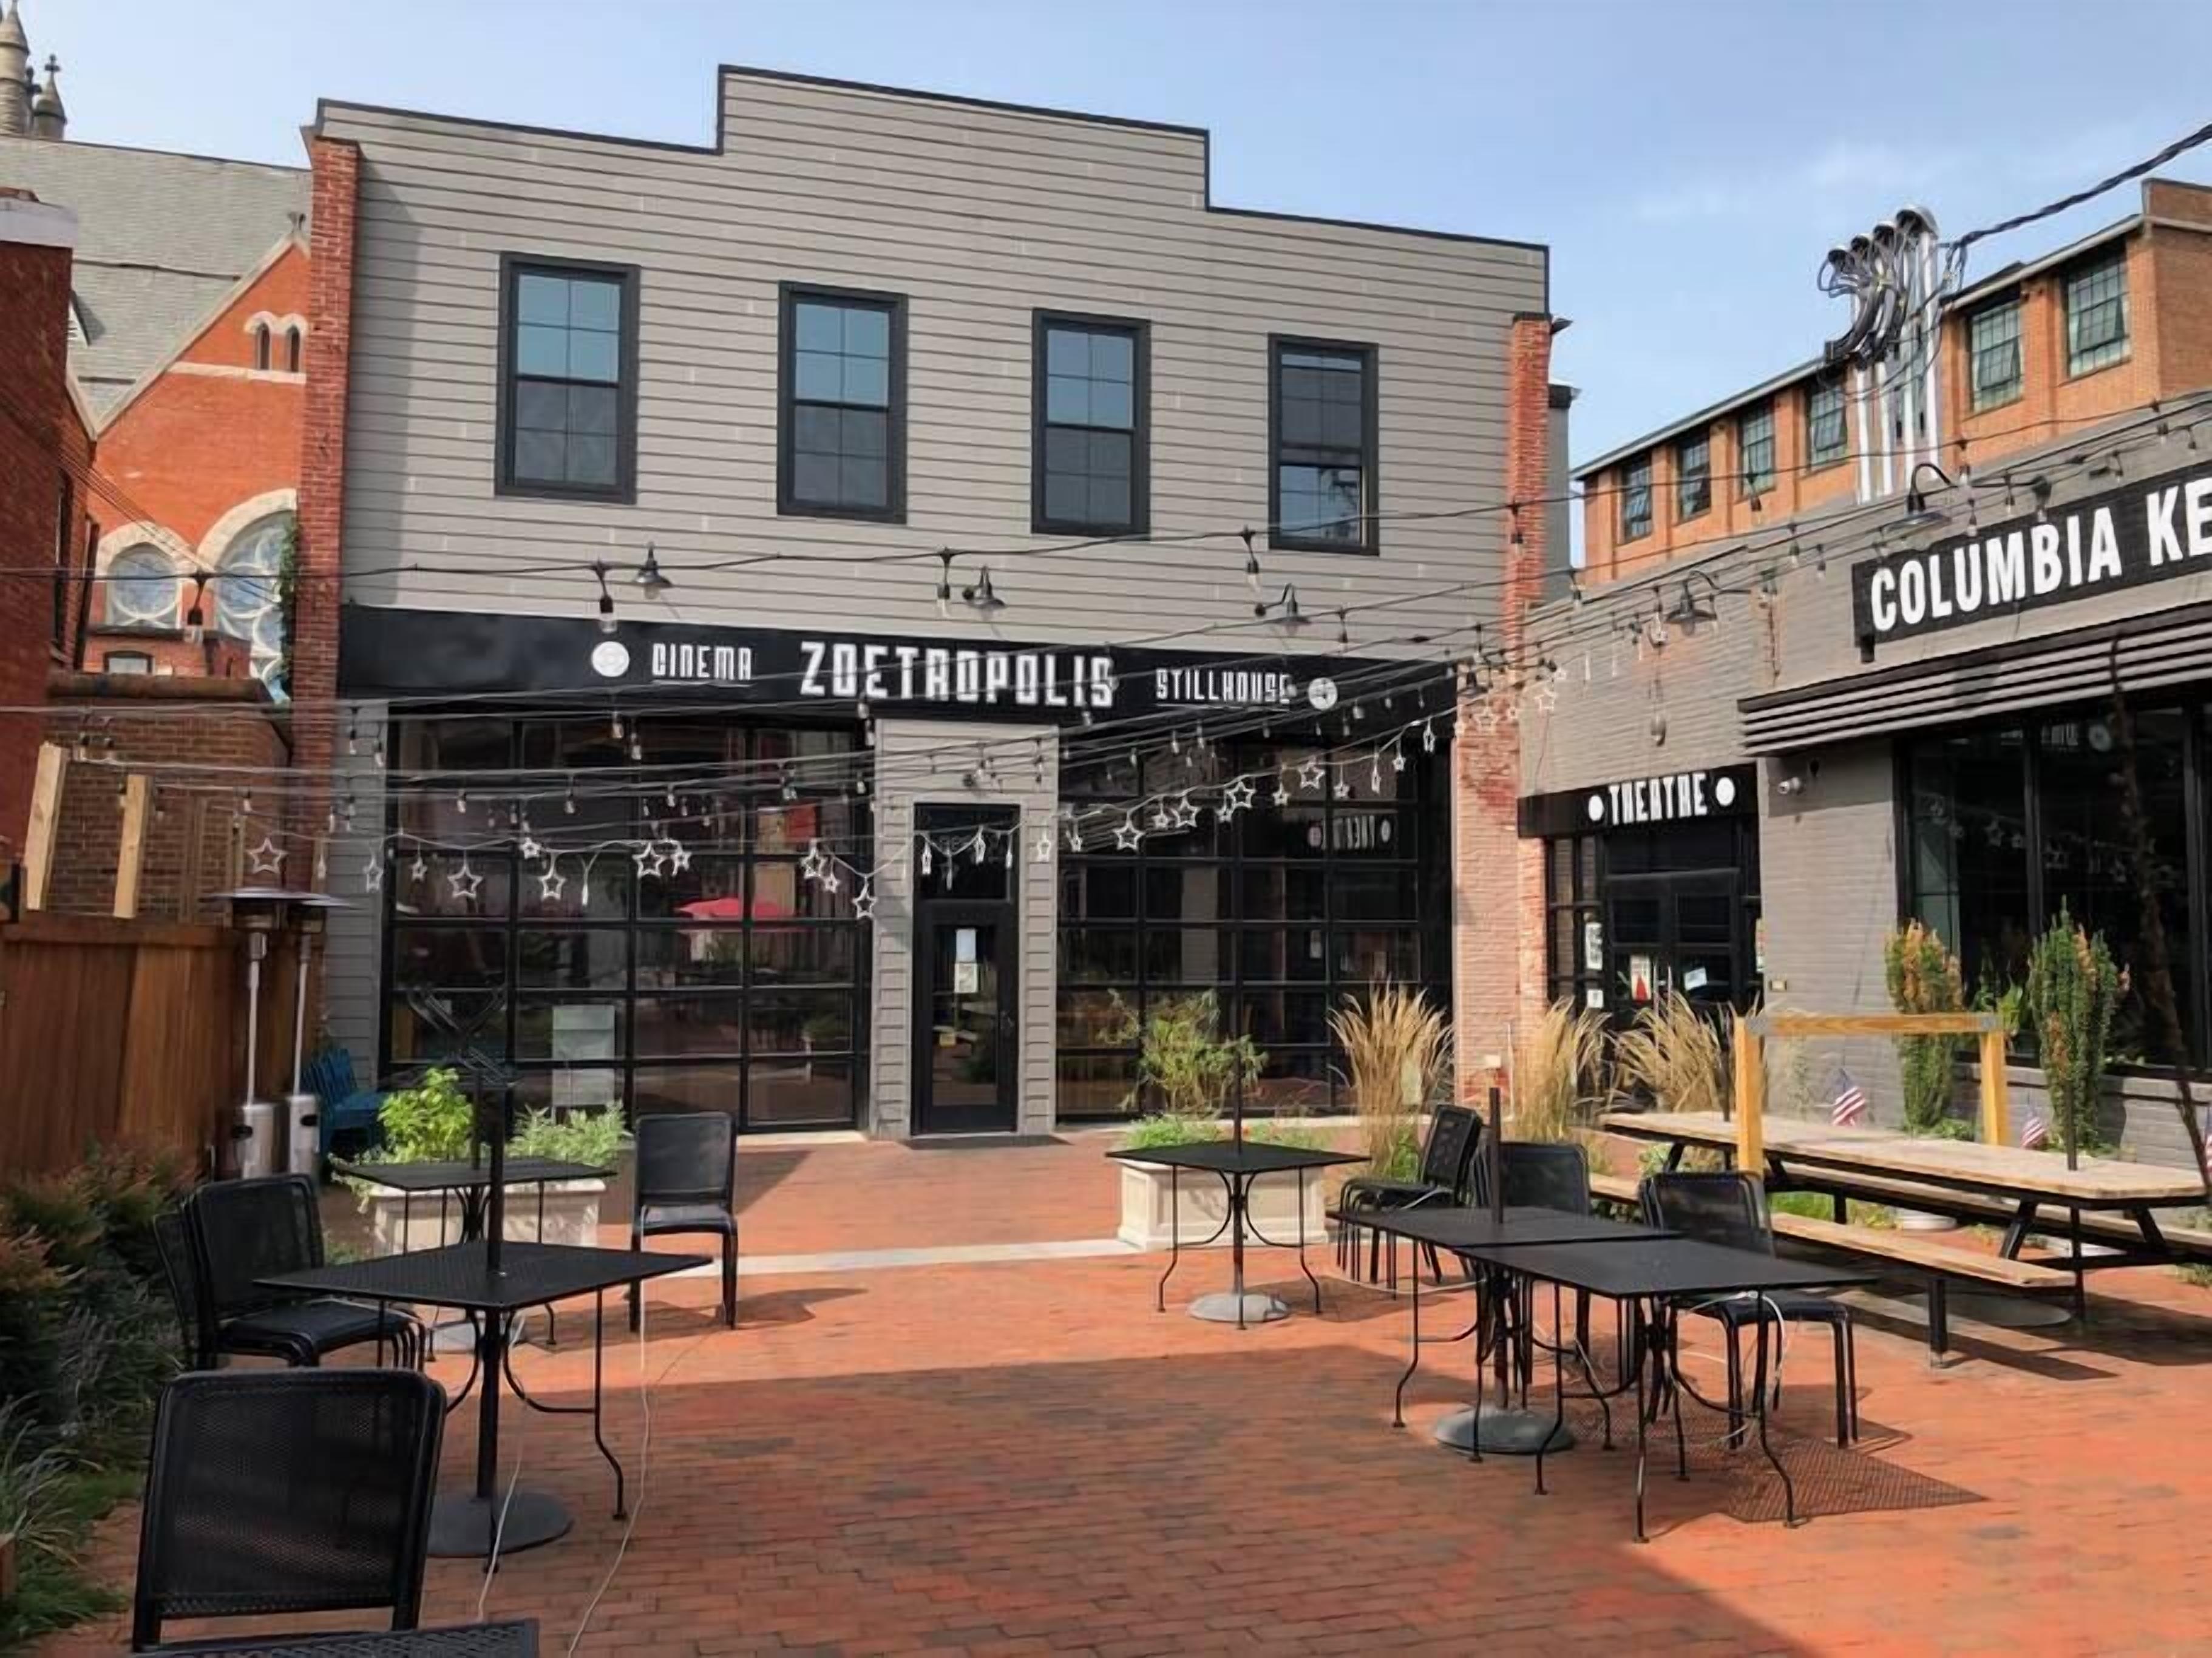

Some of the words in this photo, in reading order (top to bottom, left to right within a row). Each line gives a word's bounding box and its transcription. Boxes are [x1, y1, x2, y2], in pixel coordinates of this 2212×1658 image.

[1871, 506, 2122, 631] COLUMBIA
[652, 643, 751, 680] CINEMA
[800, 641, 1113, 708] ZOETROPOLIS
[1156, 668, 1291, 704] STILLHOUSE
[1609, 773, 1707, 825] THEATRE
